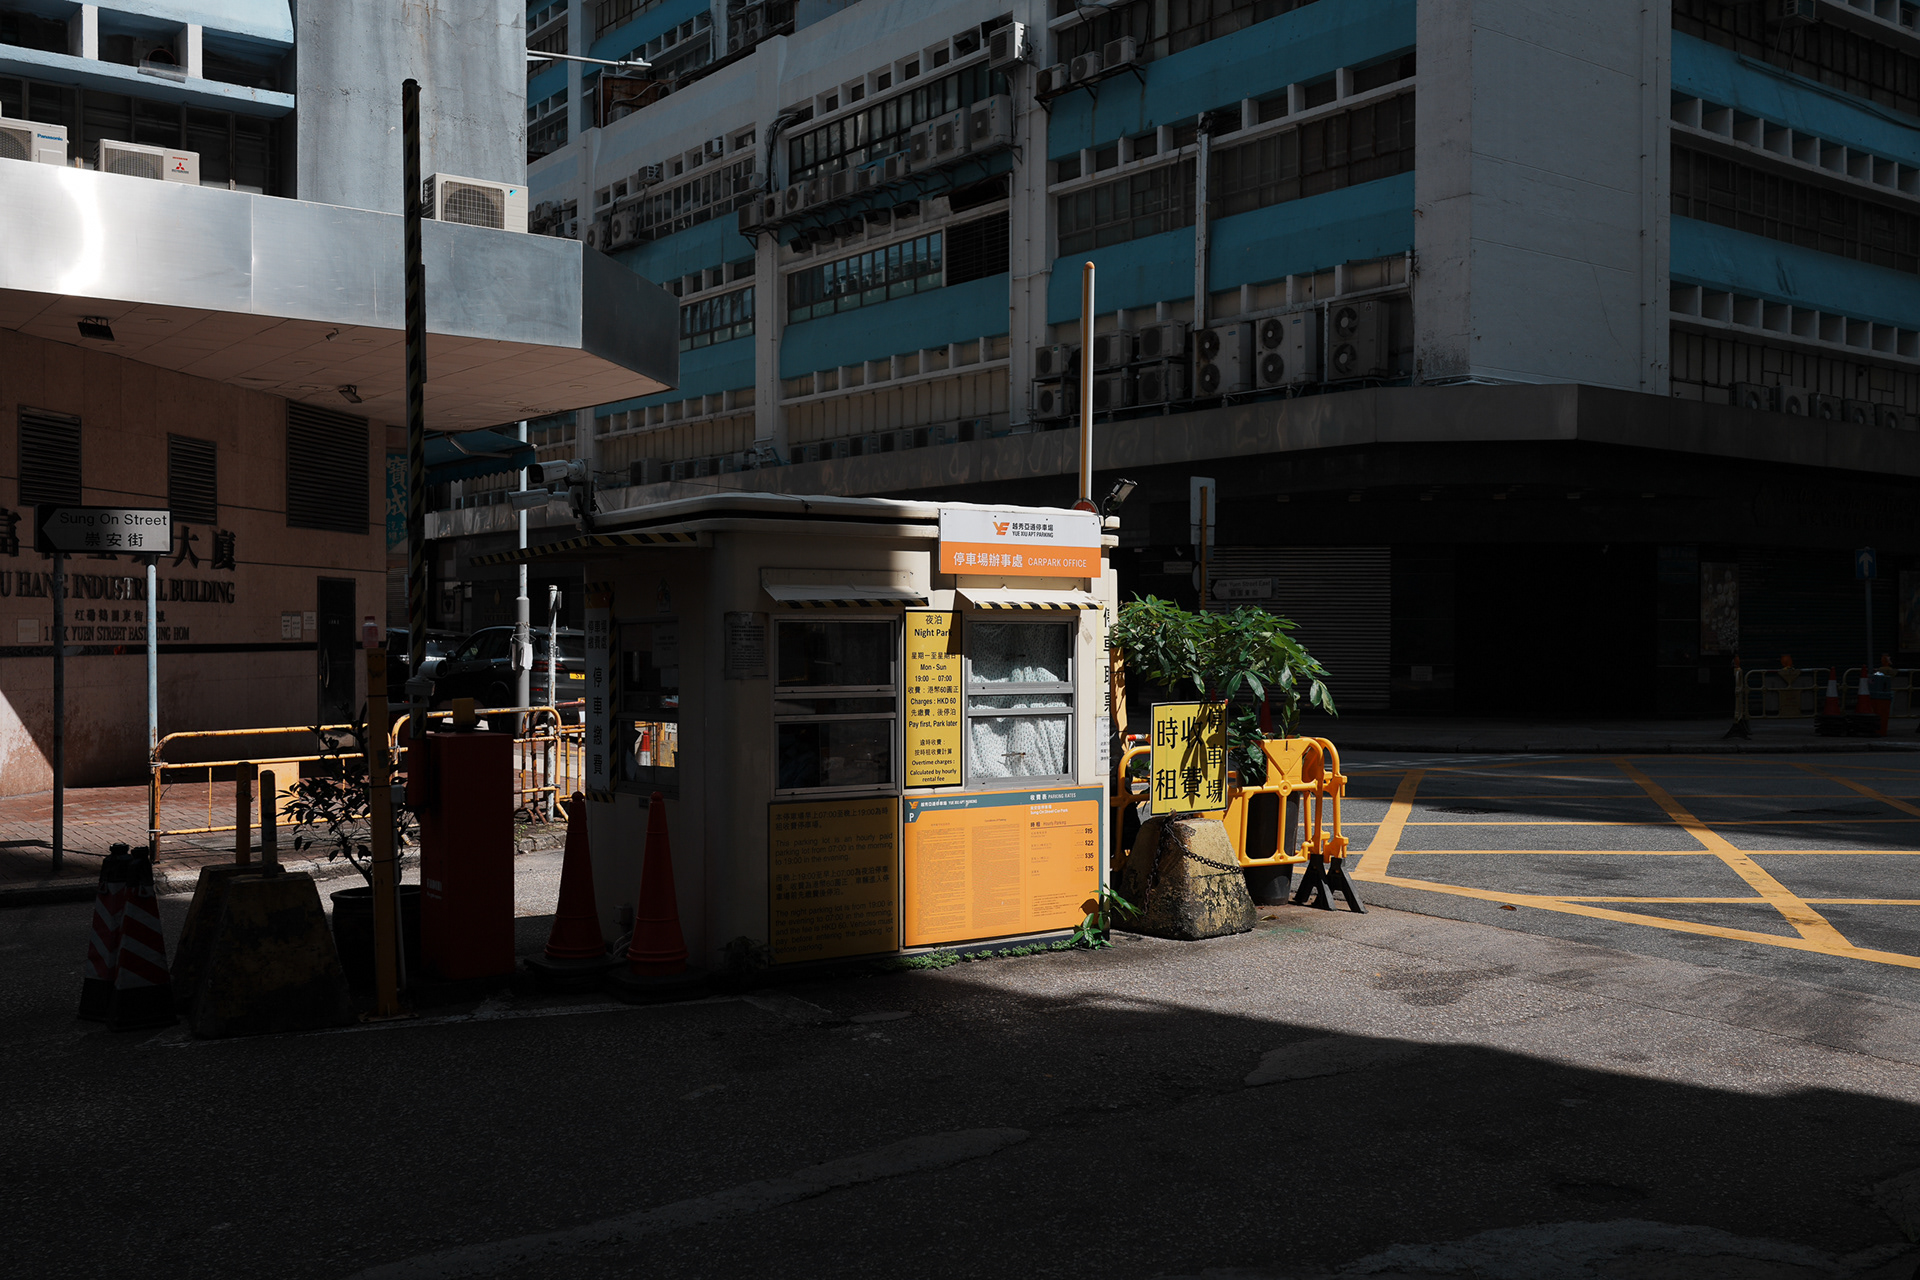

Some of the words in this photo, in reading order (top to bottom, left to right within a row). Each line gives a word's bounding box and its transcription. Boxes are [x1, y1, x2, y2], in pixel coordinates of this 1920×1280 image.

[60, 512, 94, 526] Sung
[100, 513, 118, 525] On
[124, 514, 167, 526] Street
[85, 532, 143, 547] 崇安街
[954, 552, 1023, 568] 停車場辦事處
[1028, 557, 1061, 567] CARPARK
[1063, 559, 1086, 568] OFFICE
[169, 578, 235, 604] BUILDING
[926, 615, 942, 625] 夜泊
[72, 627, 94, 640] YUEN
[97, 626, 127, 640] STREET
[915, 629, 934, 637] Night
[910, 698, 933, 706] Charges
[1156, 717, 1178, 801] 時租
[1180, 717, 1203, 800] 收費
[909, 813, 914, 821] P
[794, 838, 818, 846] parking
[856, 834, 874, 843] hourly
[776, 848, 799, 857] parking
[809, 906, 832, 915] parking
[789, 916, 814, 925] evening
[850, 919, 876, 928] Vehicles
[776, 938, 788, 946] pay
[816, 931, 842, 940] entering
[859, 927, 882, 935] parking
